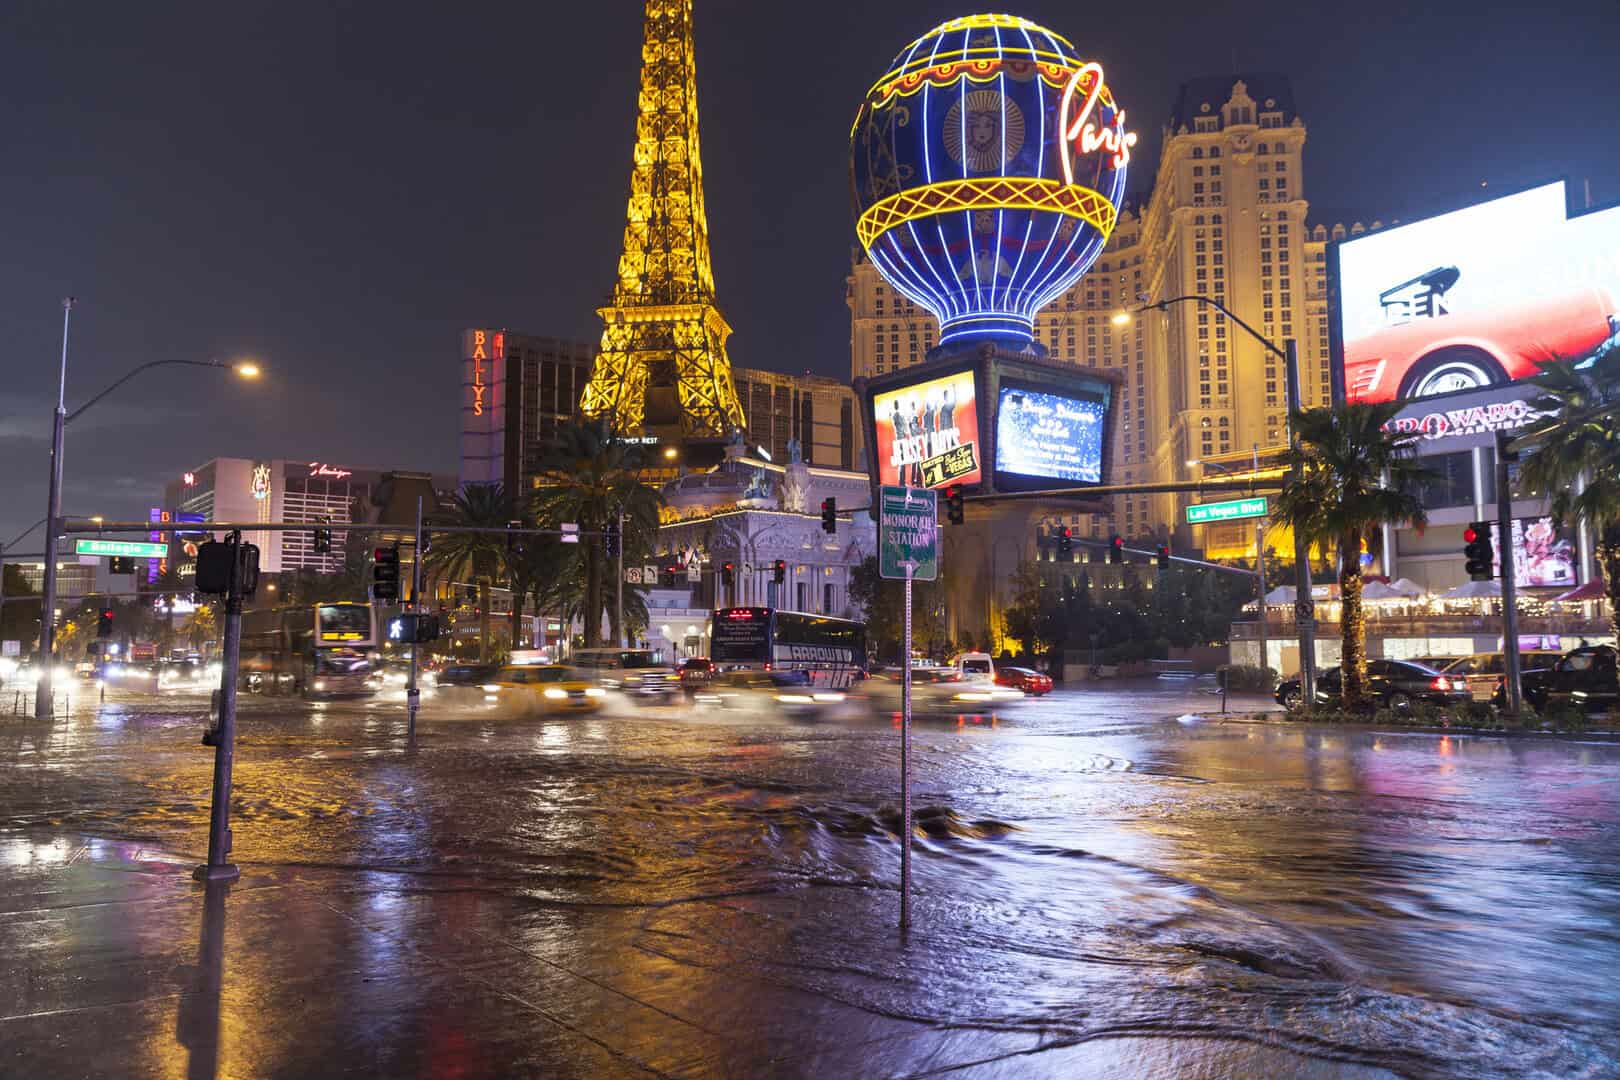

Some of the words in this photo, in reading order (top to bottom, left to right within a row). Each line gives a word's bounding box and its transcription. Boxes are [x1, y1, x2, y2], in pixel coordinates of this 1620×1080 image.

[1059, 61, 1137, 186] Paris
[1455, 418, 1526, 436] CANTINA
[890, 432, 929, 468] JERSEY
[1189, 509, 1207, 519] Las
[1208, 504, 1238, 518] Vegas
[1240, 501, 1264, 514] Blvd
[883, 512, 934, 529] MONORAIL
[888, 530, 930, 549] STATION
